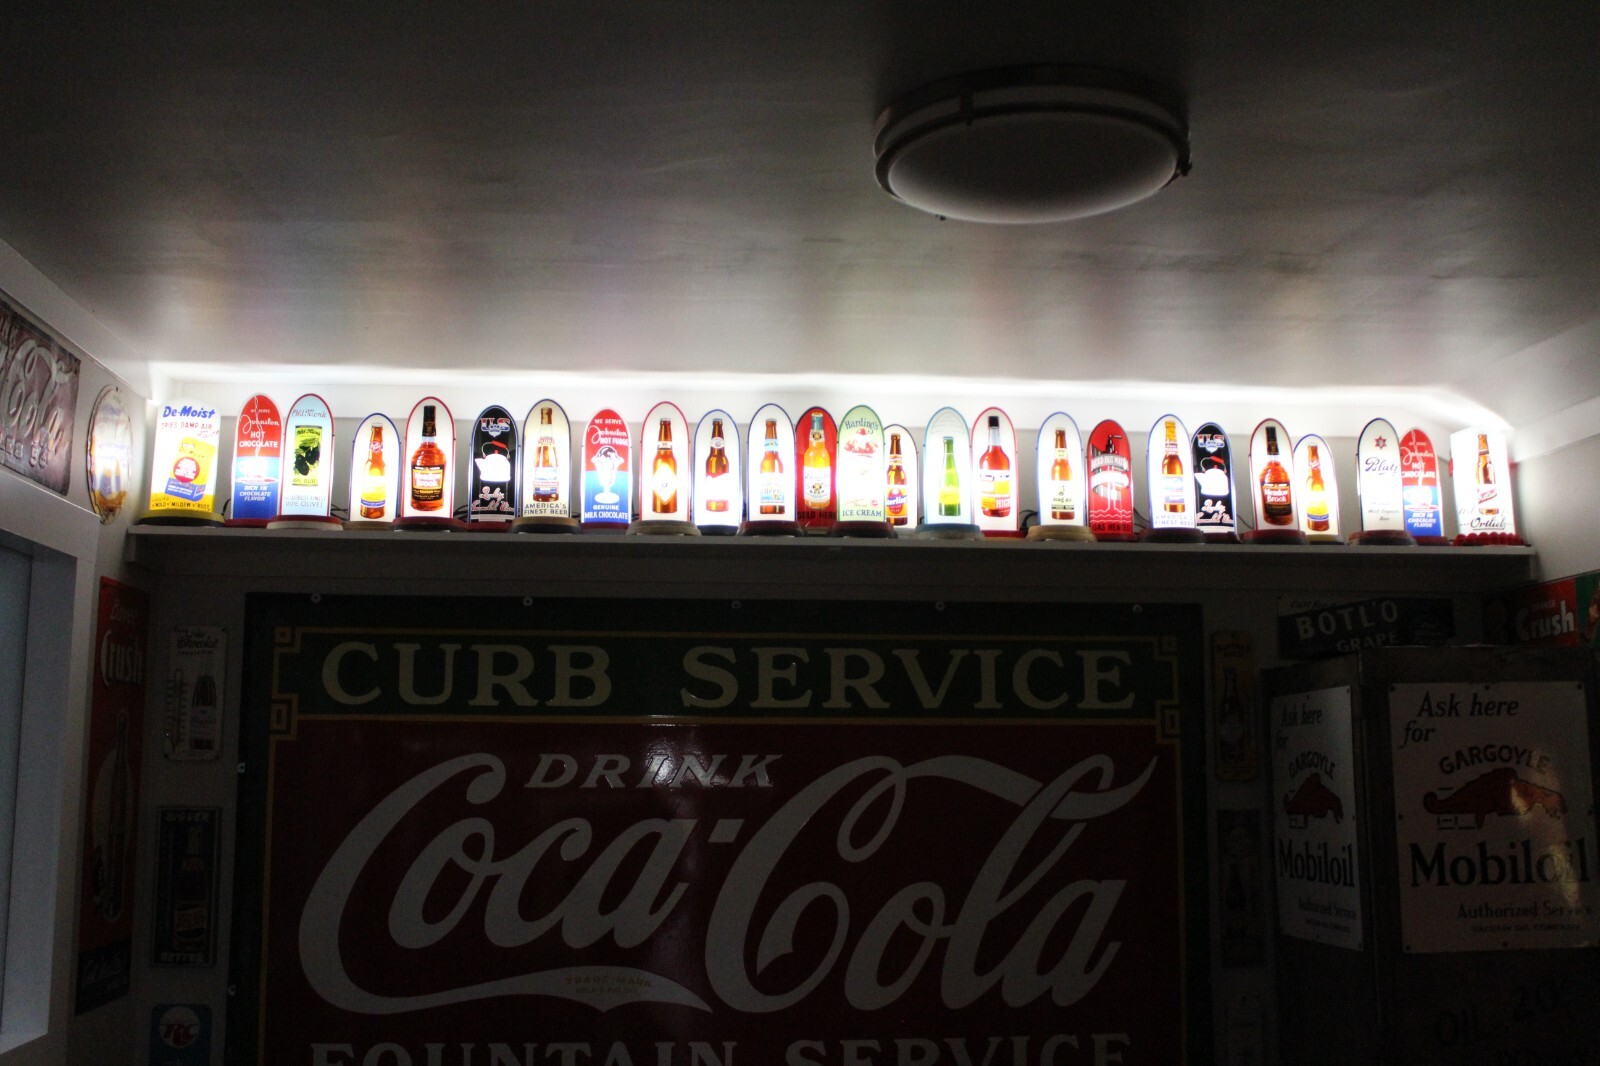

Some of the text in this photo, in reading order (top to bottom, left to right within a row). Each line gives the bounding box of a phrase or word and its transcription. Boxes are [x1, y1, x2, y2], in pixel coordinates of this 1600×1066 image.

[162, 405, 216, 419] De-Moist
[200, 423, 213, 431] AIR
[844, 418, 879, 434] Harding's
[239, 440, 279, 448] CHOCOLATE
[613, 438, 629, 446] FUDGE
[1411, 462, 1425, 470] HOT
[598, 512, 629, 520] CHOCOLATE
[856, 509, 882, 517] CREAM
[1296, 599, 1399, 641] BOTL'O
[1515, 600, 1576, 642] Crush
[1336, 630, 1399, 653] GRAPE
[101, 629, 143, 687] Crush
[321, 641, 1137, 712] CURB SERVICE
[1281, 703, 1323, 727] Ask here
[1417, 691, 1520, 718] Ask here
[1275, 729, 1289, 753] for
[1400, 720, 1436, 750] for
[525, 752, 784, 790] DRINK
[1288, 750, 1336, 780] GARGOYLE
[1439, 744, 1551, 776] GARGOYLE
[1278, 838, 1355, 888] Mobiloil
[1408, 836, 1591, 888] Mobiloil
[299, 752, 1159, 1015] Coca-Cola
[1457, 902, 1538, 920] Authorized
[616, 976, 652, 987] MARK
